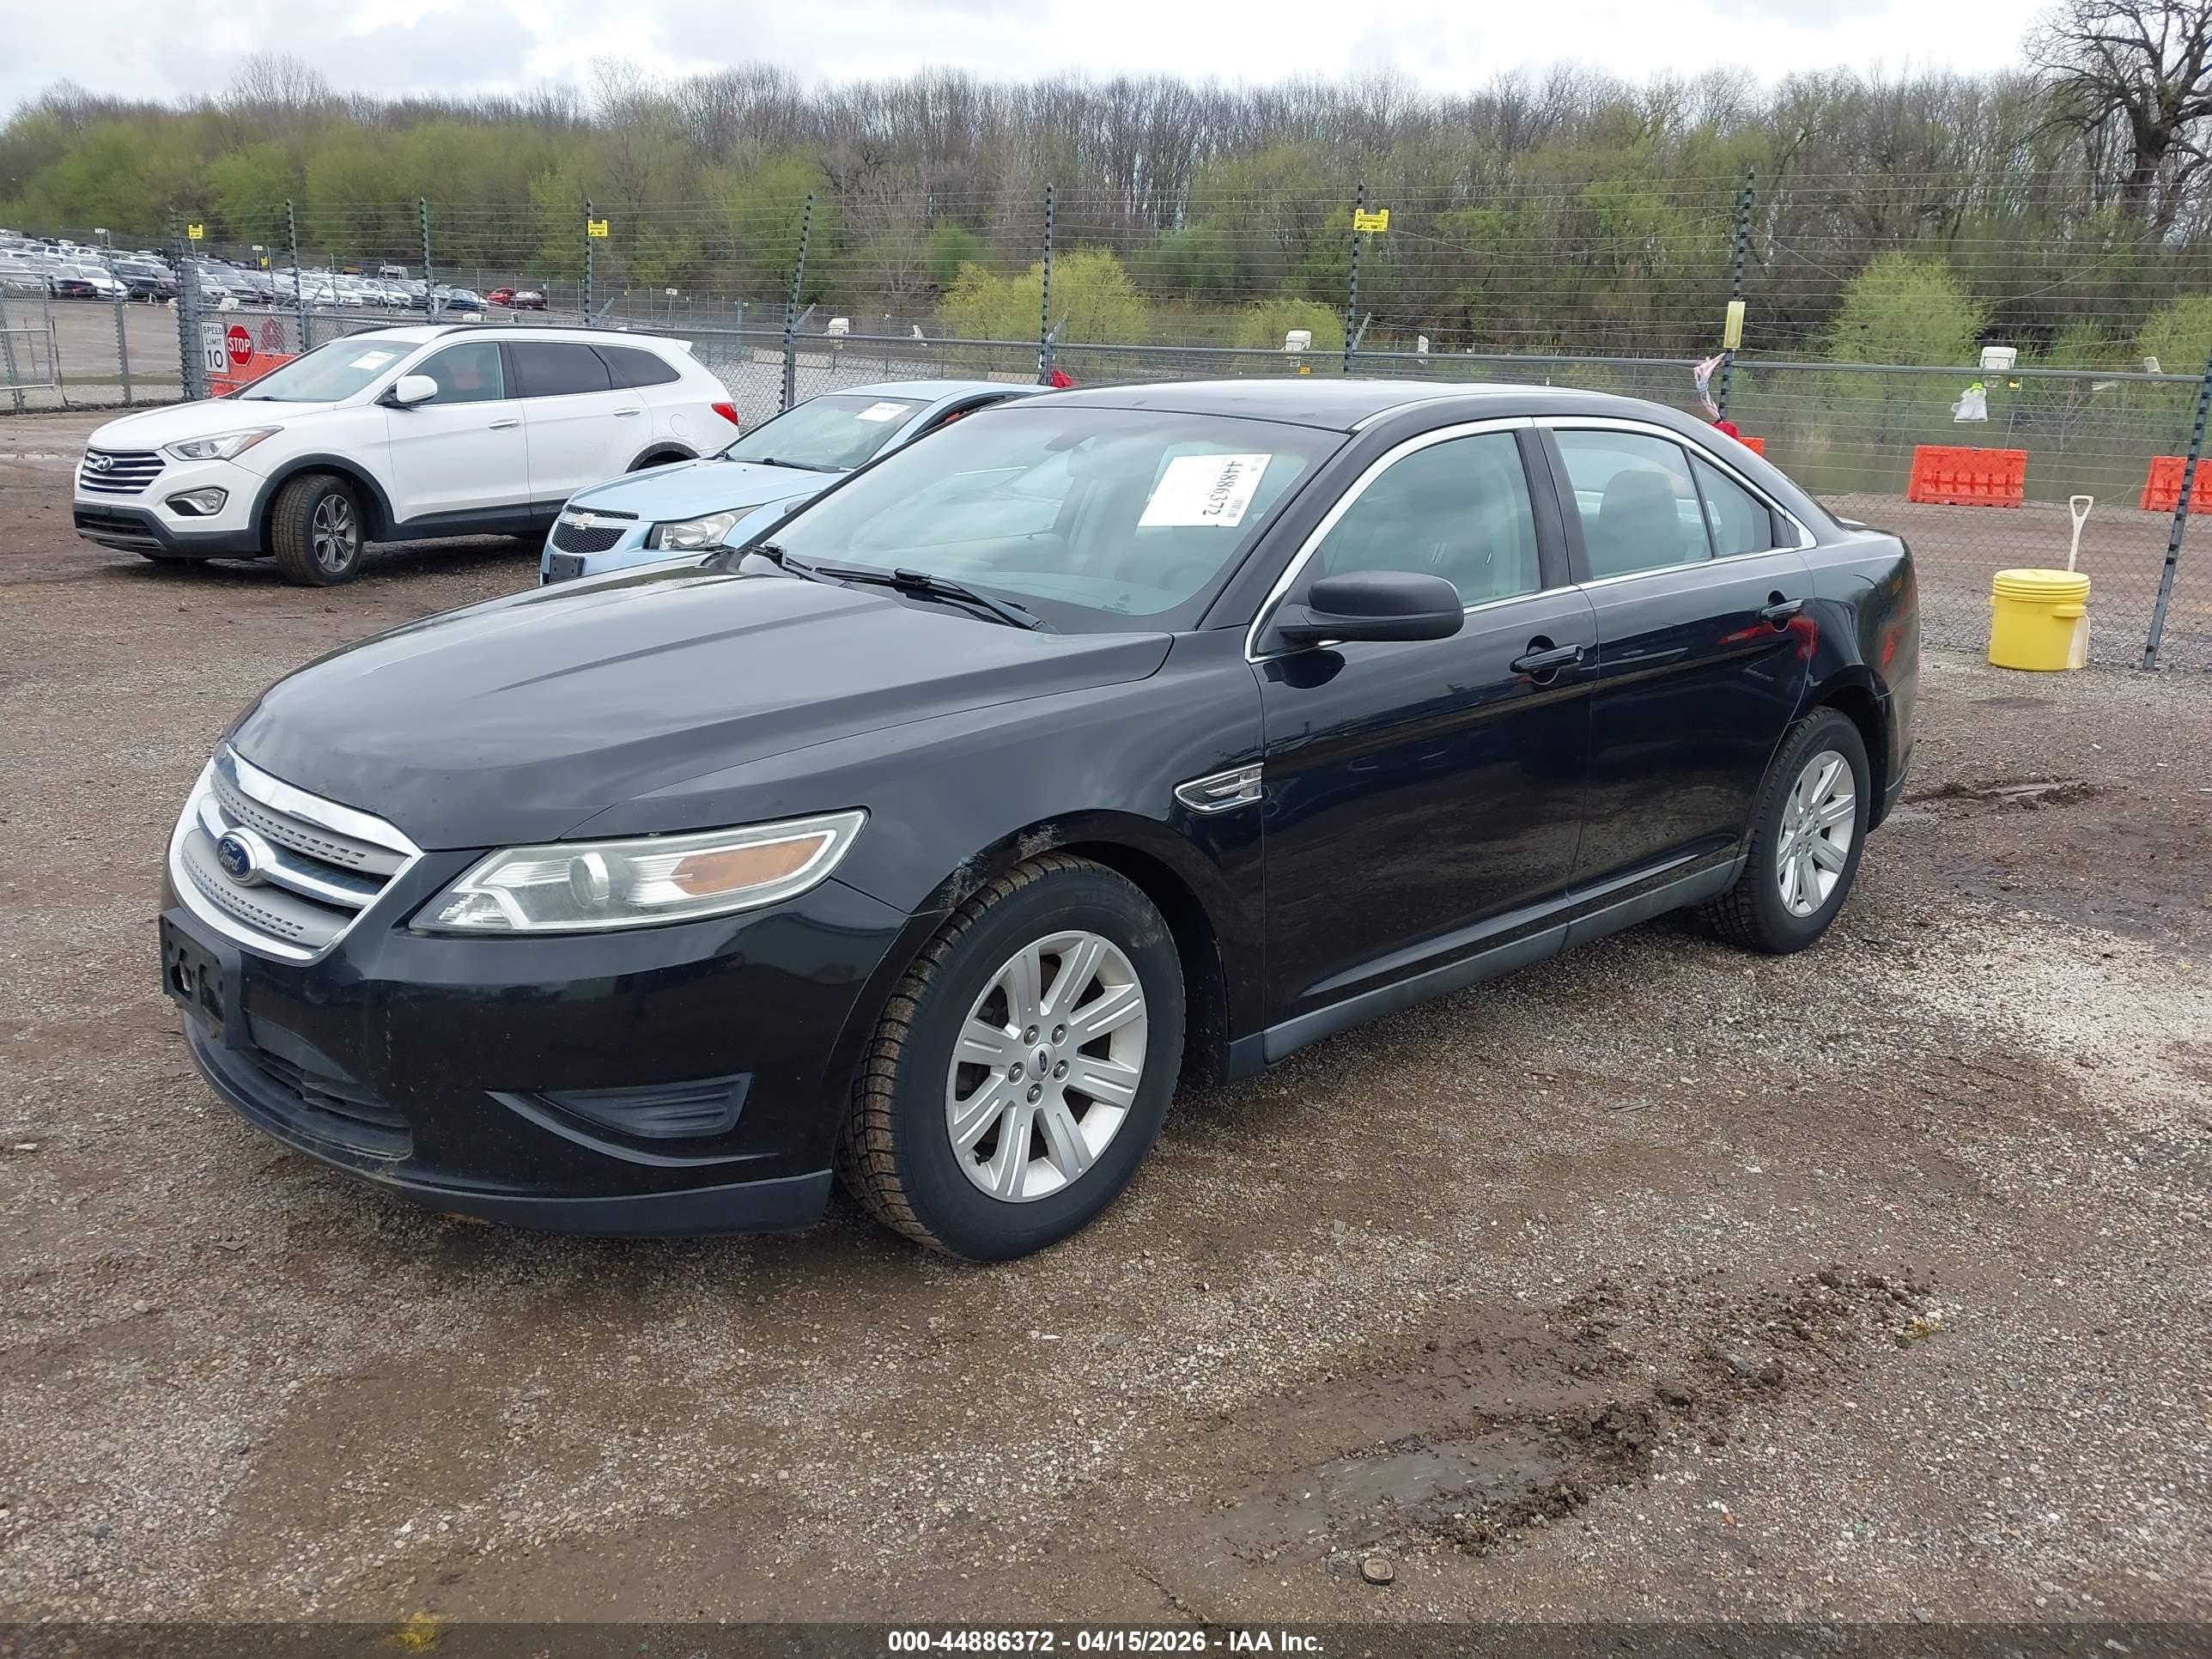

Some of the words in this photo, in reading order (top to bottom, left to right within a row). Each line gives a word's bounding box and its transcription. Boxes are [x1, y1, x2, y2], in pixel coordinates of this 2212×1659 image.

[203, 326, 222, 335] SPEED
[206, 337, 222, 346] LIMIT
[228, 337, 250, 353] STOP
[207, 349, 223, 368] 10
[1202, 460, 1243, 515] 44886372
[220, 841, 241, 872] Ford
